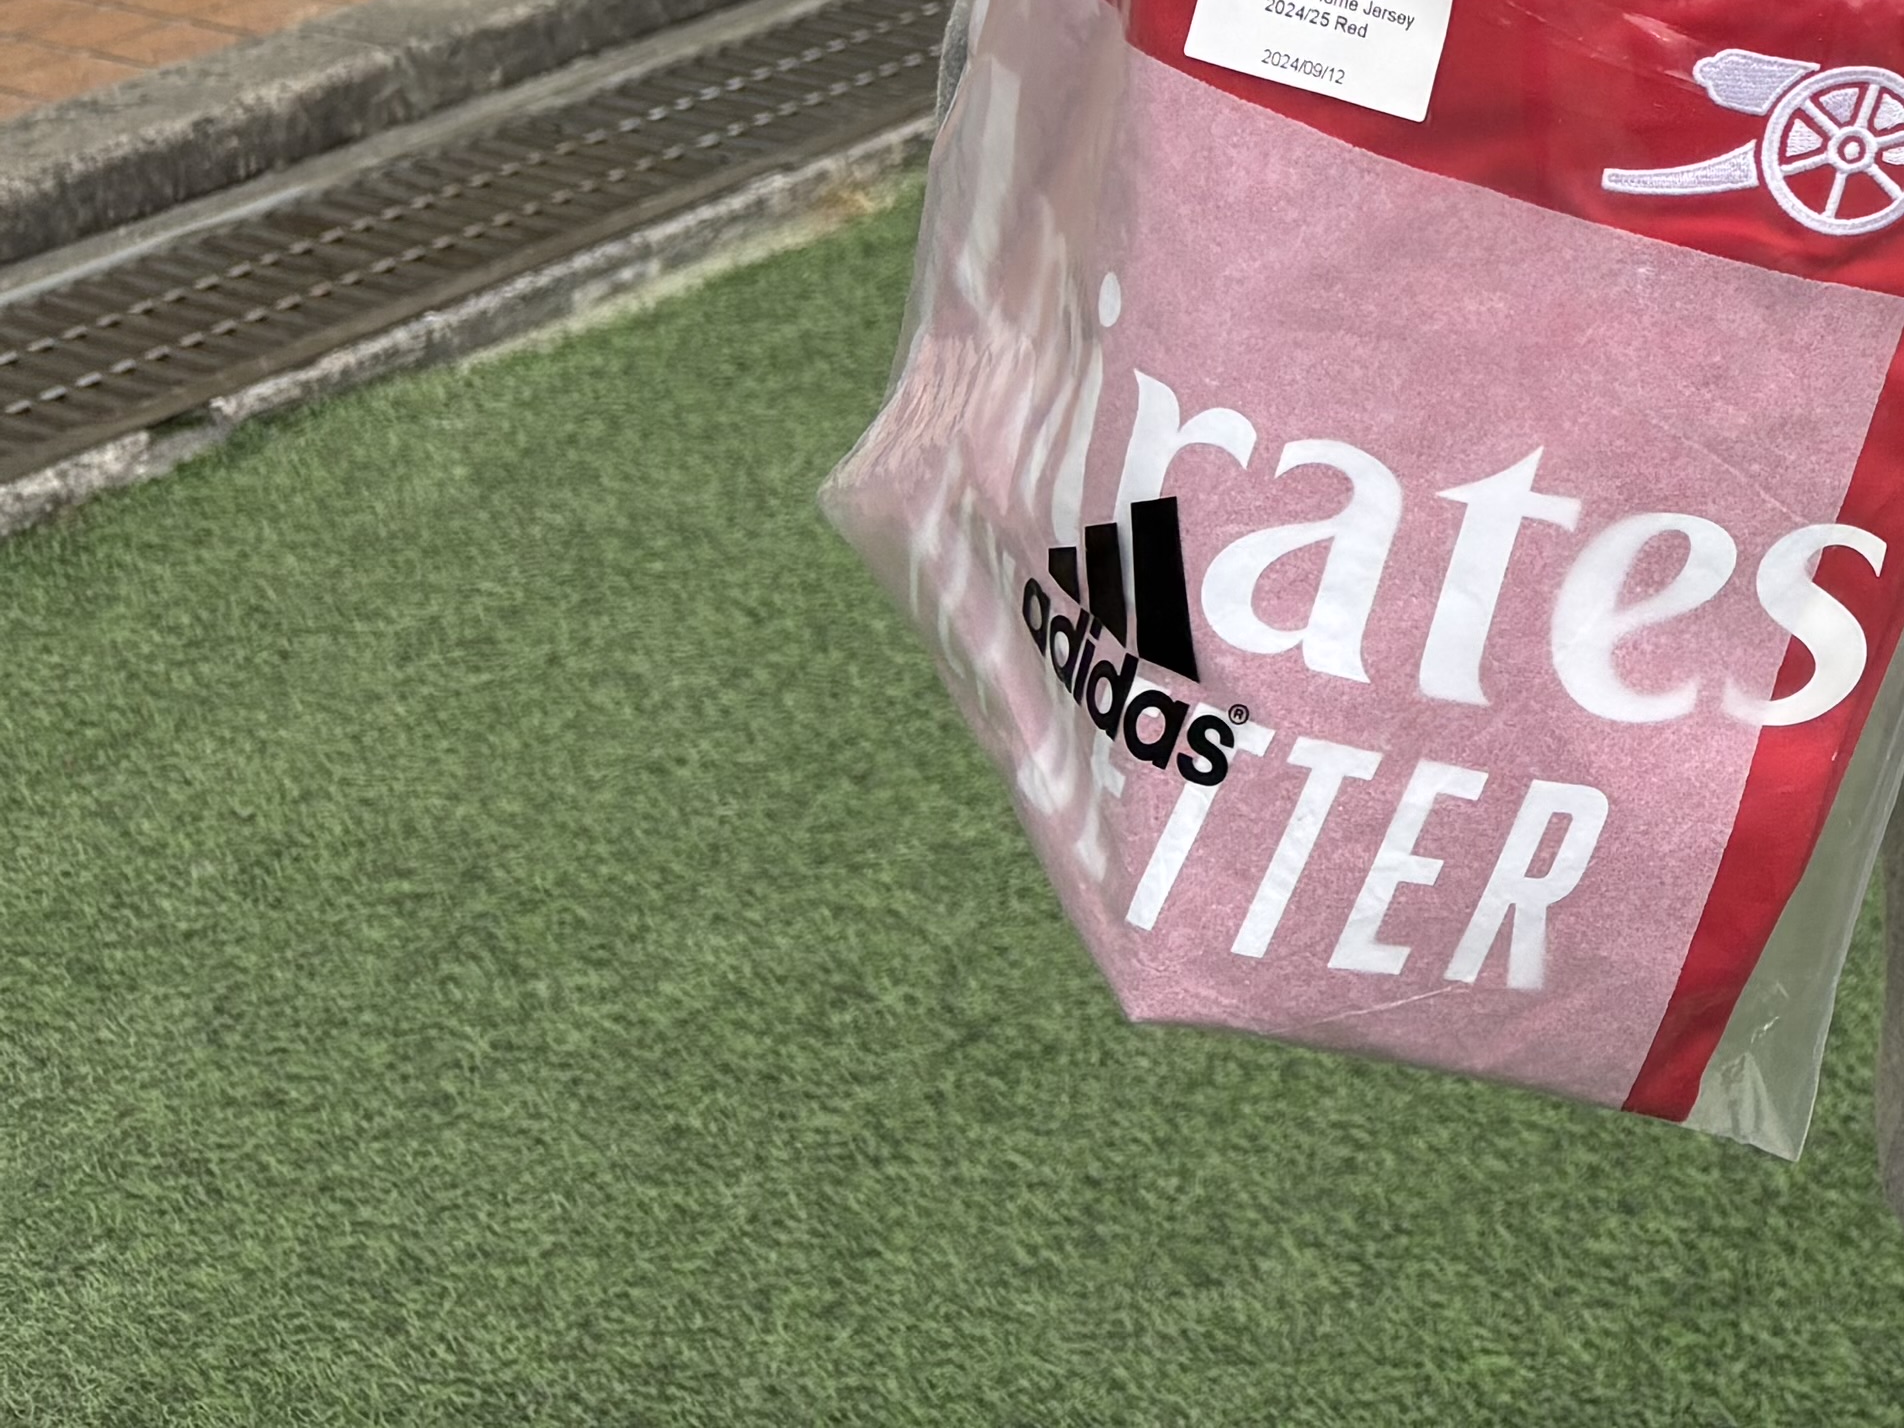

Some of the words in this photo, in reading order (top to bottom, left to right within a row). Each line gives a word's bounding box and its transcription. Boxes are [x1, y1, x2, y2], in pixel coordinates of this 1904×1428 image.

[1334, 16, 1369, 39] Red
[1363, 1, 1415, 31] Jersey
[1261, 49, 1346, 85] 2024/09/12
[1022, 577, 1235, 787] adidas
[1110, 701, 1610, 991] TTER
